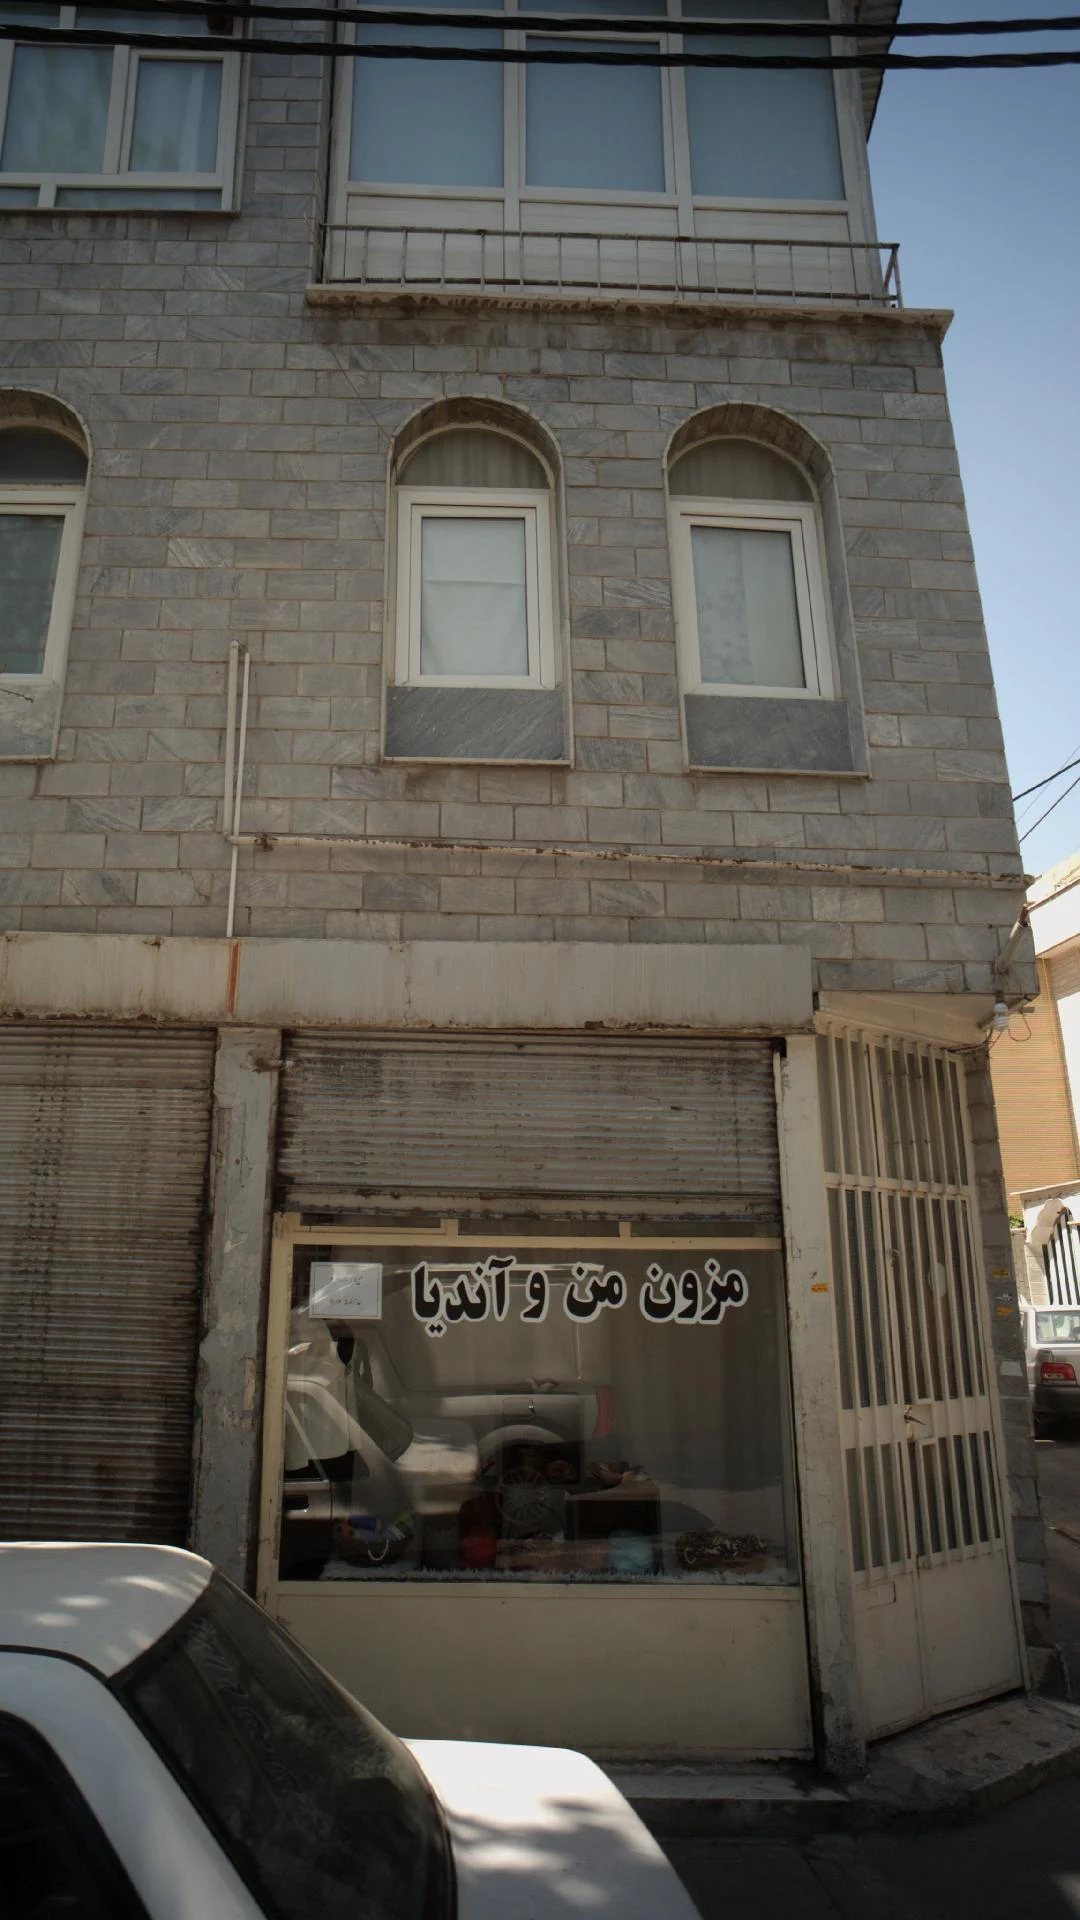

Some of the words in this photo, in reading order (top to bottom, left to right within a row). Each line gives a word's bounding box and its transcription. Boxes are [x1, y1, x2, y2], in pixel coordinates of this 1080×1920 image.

[411, 1255, 517, 1338] آندیا
[520, 1269, 550, 1323] و
[563, 1262, 628, 1324] من
[639, 1258, 749, 1325] مزون
